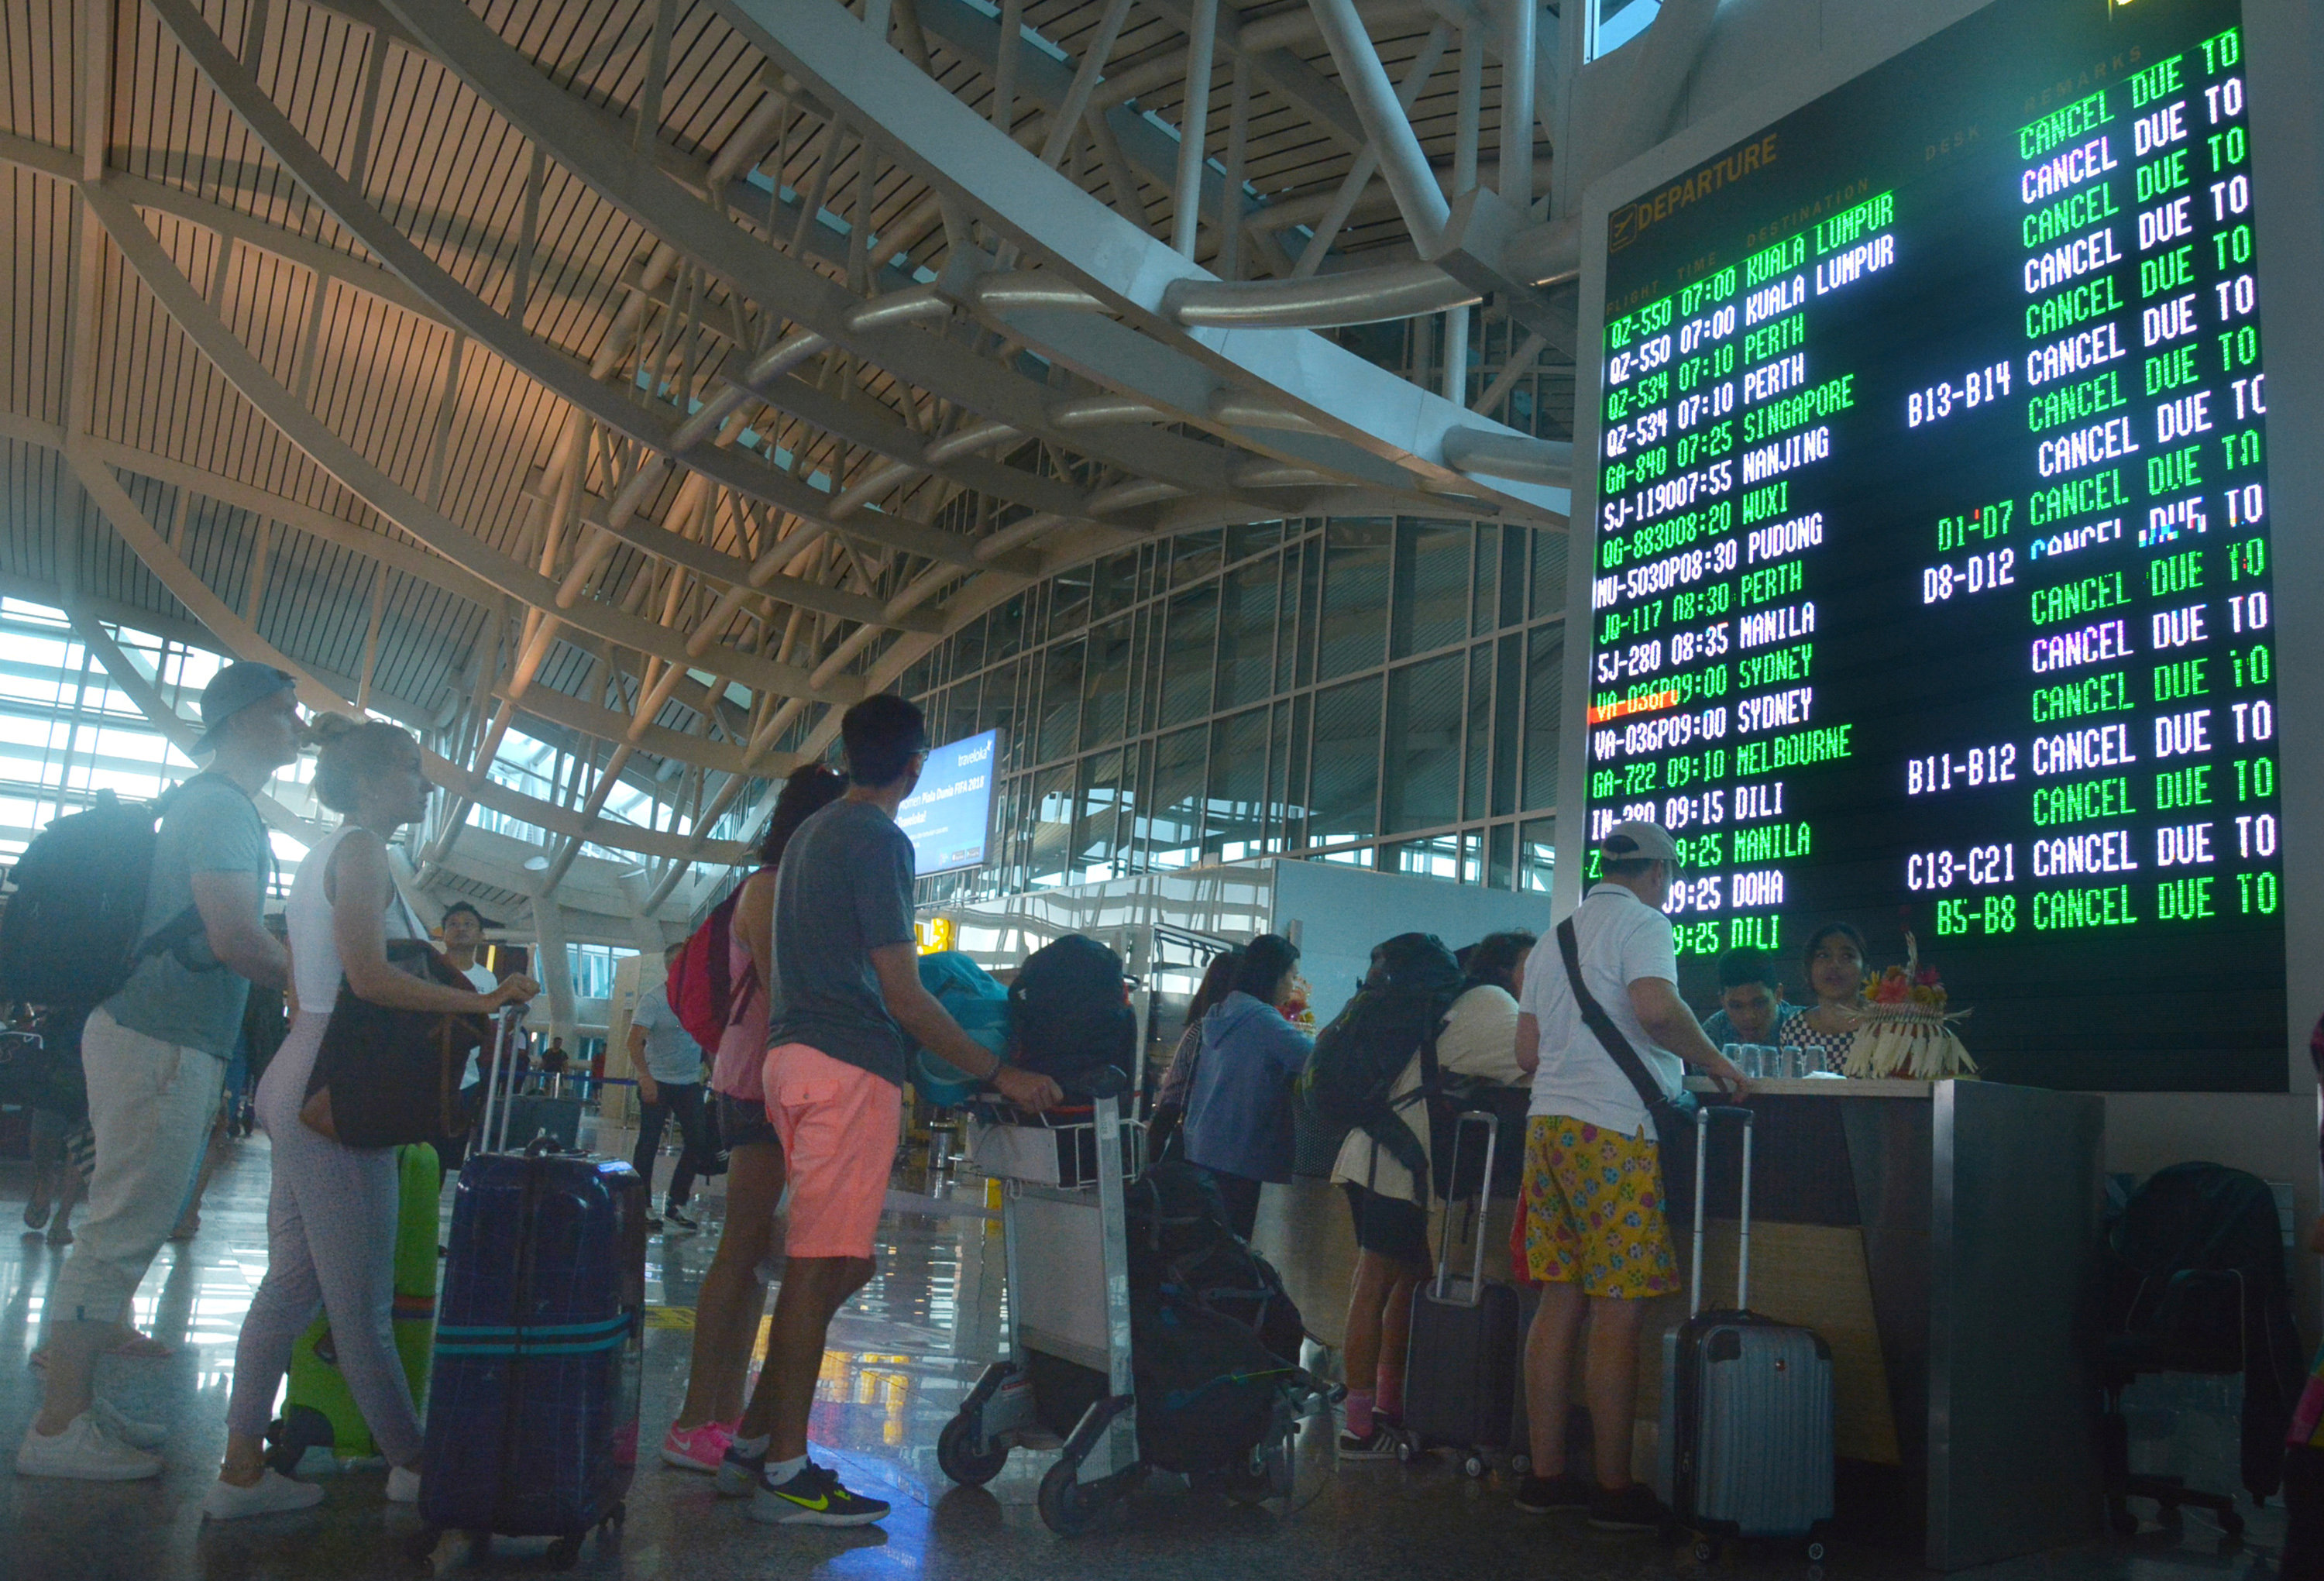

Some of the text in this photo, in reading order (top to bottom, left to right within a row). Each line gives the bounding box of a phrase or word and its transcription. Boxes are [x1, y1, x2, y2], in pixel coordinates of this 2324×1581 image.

[1606, 46, 2141, 315] FLIGHT TIME DESTINATION DESK REMARKS
[1611, 29, 2239, 349] QZ-550 07:00 KUALA LUMPUR CANCEL DUE TO
[1611, 78, 2242, 384] QZ-550 07:00 KUALA LUMPUR CANCEL DUE TO
[1638, 133, 1777, 231] DEPARTURE
[1607, 175, 2247, 457] QZ-534 07:10 PERTH CANCEL DUE TO
[1608, 126, 2245, 421] QZ-534 07:10 PERTH CANCEL DUE TO
[1606, 225, 2250, 494] GA-840 07:25 SINGAPORE CANCEL DUE TO
[1743, 427, 1828, 484] NANJING
[1909, 361, 2010, 427] B13-B14
[2028, 323, 2125, 385] CANCEL
[2144, 294, 2196, 346] DUE
[2216, 275, 2253, 320] TO
[1743, 481, 1787, 524] WUXI
[2029, 371, 2126, 432] CANCEL
[2146, 344, 2199, 396] DUE
[2219, 326, 2256, 371] TO
[1741, 560, 1803, 607] PERTH
[2030, 469, 2130, 525] CANCEL
[2148, 445, 2202, 496] DUE
[1748, 513, 1823, 564] PUDONG
[2039, 417, 2139, 477] CANCEL
[2157, 391, 2212, 442] DUE
[1671, 622, 1728, 665] 08:35
[1740, 602, 1814, 649] MANILA
[1924, 548, 2014, 604] D8-D12
[2225, 484, 2262, 527] TO
[1739, 643, 1812, 688] SYDNEY
[2032, 572, 2131, 625] CANCEL
[2150, 551, 2203, 596] DUE
[2226, 538, 2264, 581] TO
[1593, 762, 1656, 798] GA-722
[1667, 750, 1725, 787] 09:10
[1737, 724, 1851, 776] MELBOURNE
[2033, 672, 2134, 723] CANCEL
[2154, 658, 2209, 701] DUE
[1738, 687, 1811, 733] SYDNEY
[2033, 620, 2133, 672] CANCEL
[2154, 605, 2208, 648] DUE
[2229, 592, 2267, 632] TO
[937, 785, 954, 800] Dunia
[954, 780, 968, 796] FIFA
[968, 775, 985, 792] 2018
[958, 746, 988, 767] traveloka
[1666, 790, 1724, 830] 09:15
[1736, 782, 1783, 820] DILI
[1908, 744, 2016, 795] B11-B12
[2033, 724, 2135, 775] CANCEL
[2156, 710, 2211, 757] DUE
[2233, 701, 2271, 742] TO
[1675, 758, 2273, 868] 9:25 MANILA CANCEL DUE TO
[1673, 871, 2276, 955] 9:25 DILI B5-B8 CANCEL DUE TO
[1733, 870, 1783, 907] DOHA
[1908, 844, 2014, 890] C13-C21
[2033, 831, 2137, 876] CANCEL
[2158, 823, 2213, 866] DUE
[2236, 815, 2274, 858] TO
